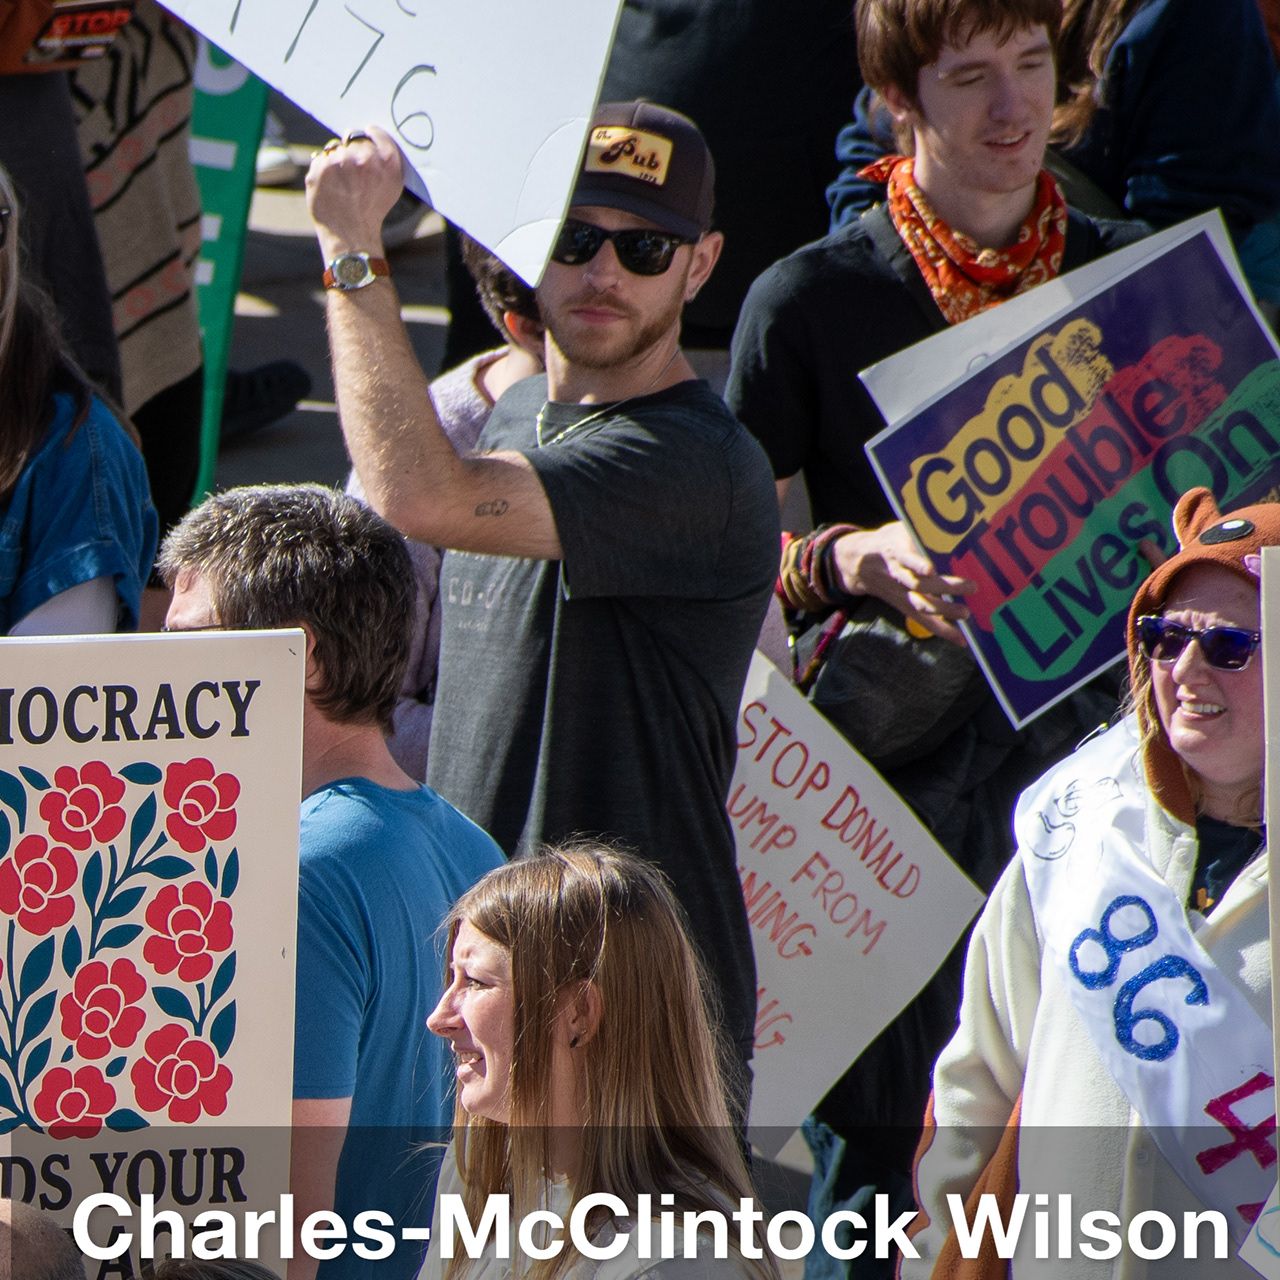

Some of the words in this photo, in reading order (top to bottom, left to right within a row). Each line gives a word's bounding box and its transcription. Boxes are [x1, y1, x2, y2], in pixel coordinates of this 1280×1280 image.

[599, 136, 659, 171] Pub
[915, 346, 1088, 535] Good
[961, 379, 1189, 597] Trouble
[998, 502, 1170, 670] Lives
[1151, 407, 1280, 503] On
[725, 783, 797, 854] UMP
[789, 851, 888, 957] FROM
[737, 701, 830, 800] STOP
[819, 784, 921, 899] DONALD
[1068, 895, 1210, 1062] 86
[89, 1146, 248, 1209] YOUR
